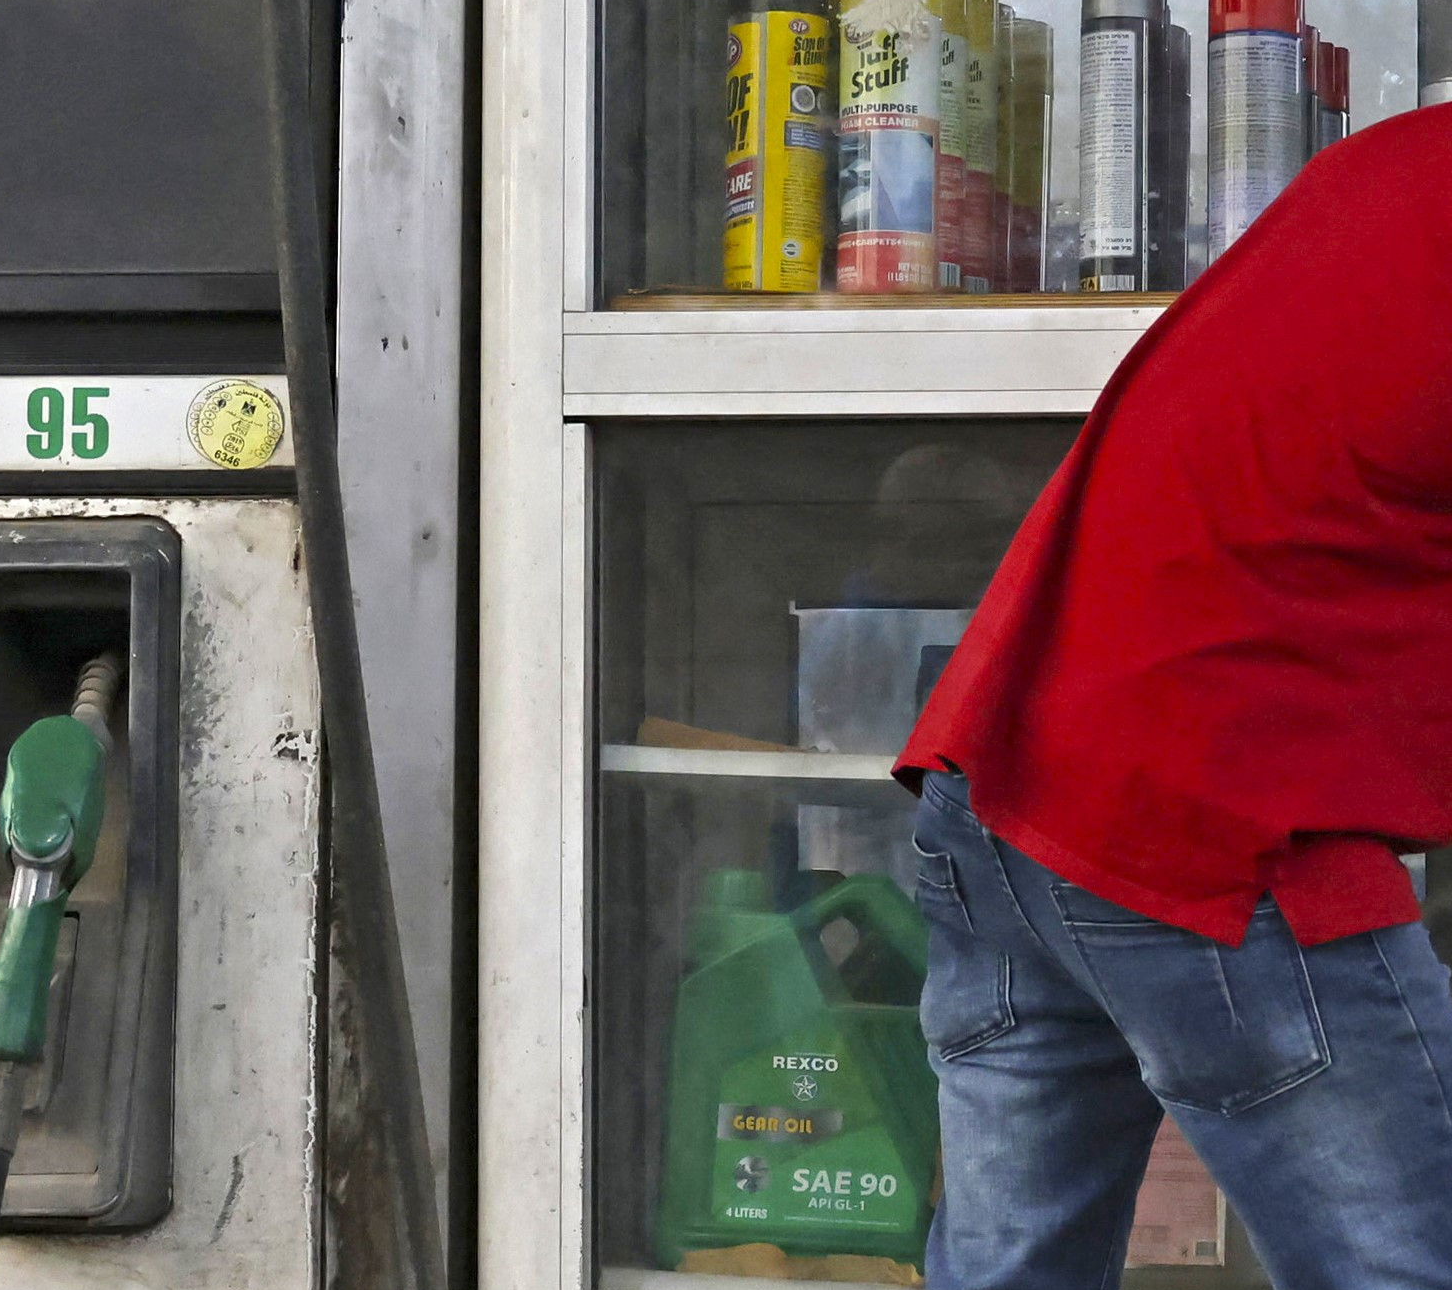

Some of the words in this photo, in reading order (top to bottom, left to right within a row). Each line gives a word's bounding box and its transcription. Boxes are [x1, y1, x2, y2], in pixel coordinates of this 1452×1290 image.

[791, 22, 809, 33] STP
[851, 57, 910, 99] Stuff
[25, 387, 110, 460] 95
[213, 449, 241, 467] 6346
[772, 1055, 839, 1072] REXCO
[732, 1114, 781, 1132] GEAR
[784, 1117, 813, 1135] OIL
[791, 1168, 853, 1195] SAE
[859, 1173, 898, 1197] 90
[807, 1196, 833, 1210] API
[834, 1198, 866, 1211] GL-1
[734, 1206, 768, 1220] LITERS
